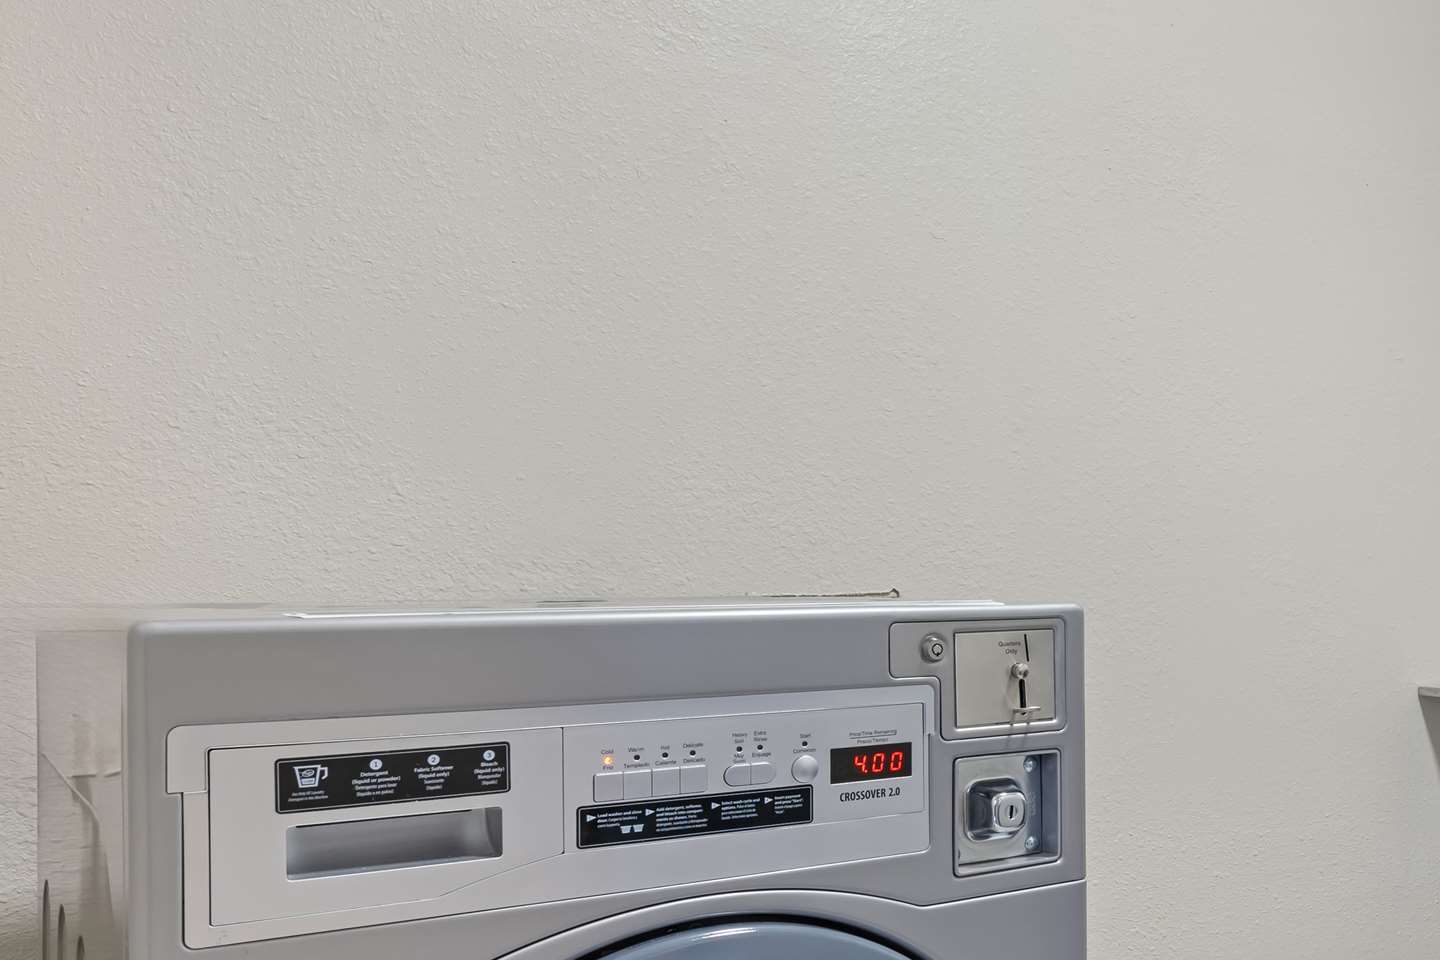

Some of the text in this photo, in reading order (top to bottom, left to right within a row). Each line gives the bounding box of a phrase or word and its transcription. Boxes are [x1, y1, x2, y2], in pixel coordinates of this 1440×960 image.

[854, 751, 903, 773] 4.00
[839, 787, 901, 802] CROSSOVER 2.0
